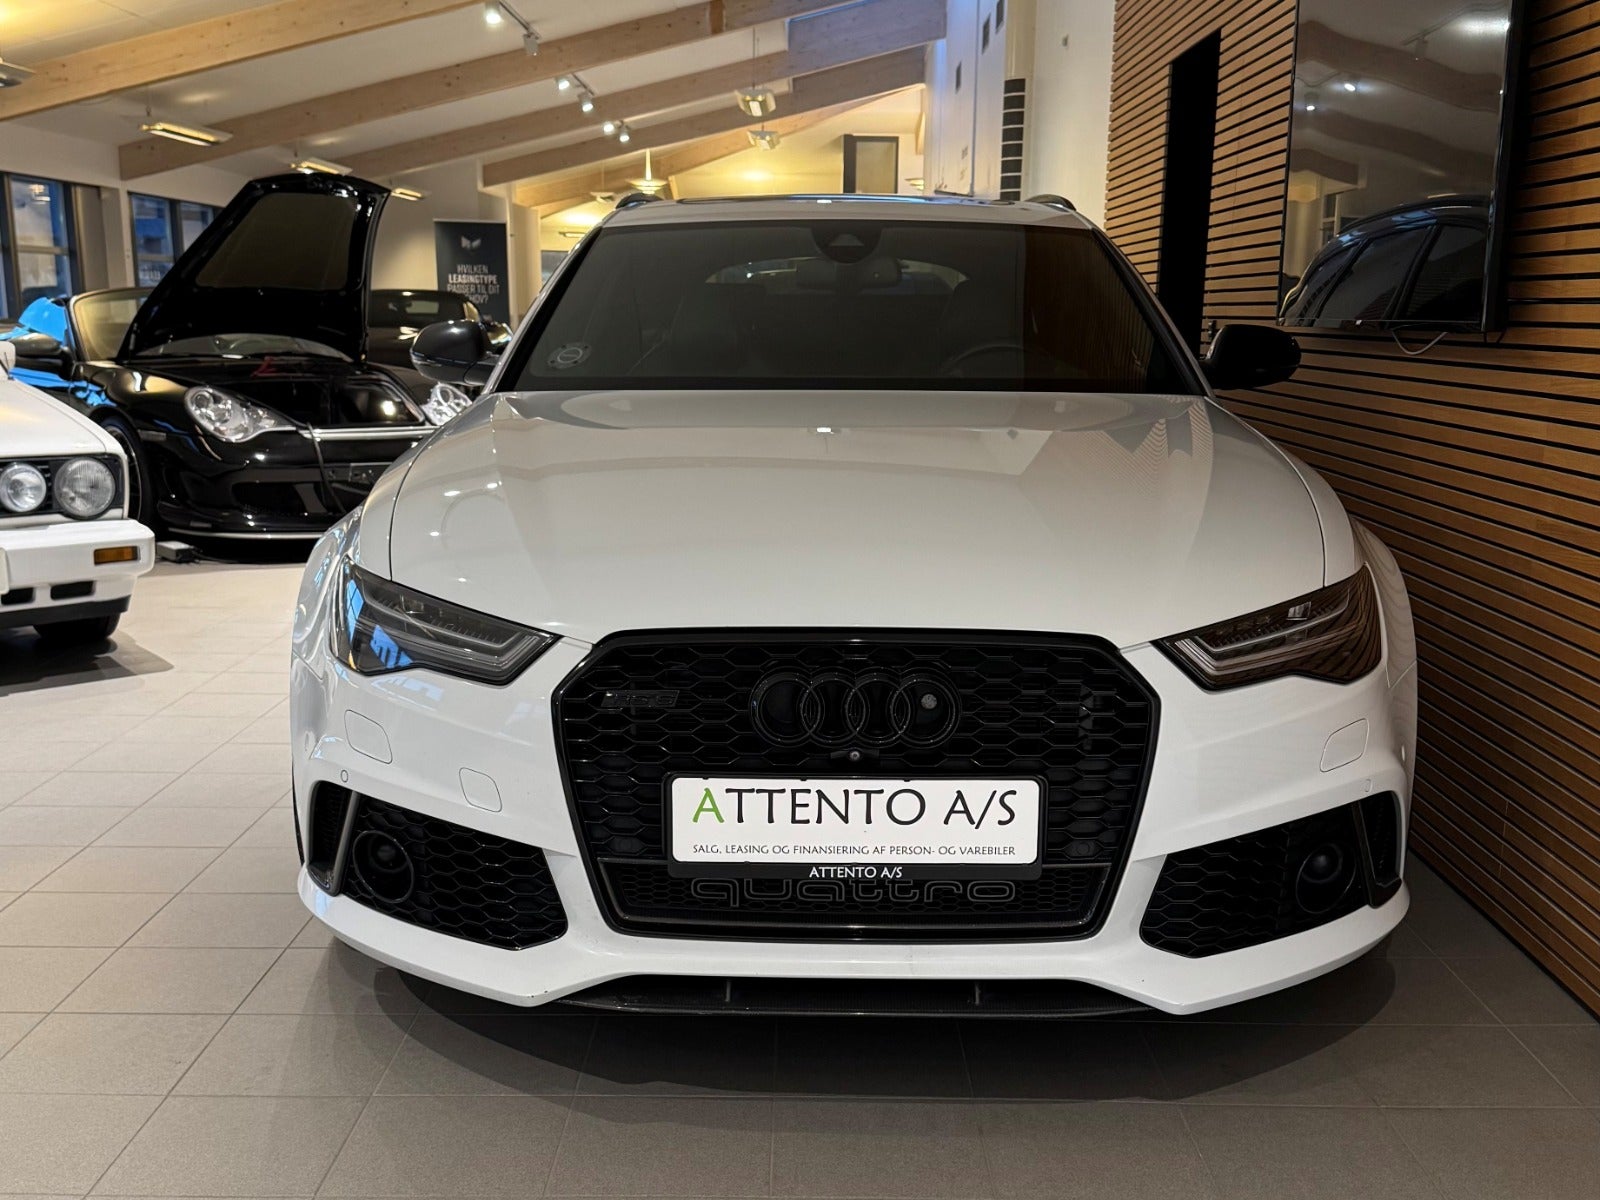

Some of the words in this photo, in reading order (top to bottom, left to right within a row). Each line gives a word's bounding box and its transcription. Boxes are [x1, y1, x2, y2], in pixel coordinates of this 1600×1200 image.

[457, 264, 489, 274] HVILKEN
[448, 273, 498, 284] LEASINGTYPE
[692, 787, 926, 826] ATTENTO
[943, 789, 1017, 830] A/S
[693, 844, 722, 855] SALG,
[725, 844, 769, 855] LEASING
[772, 844, 790, 855] OG
[793, 845, 869, 856] FINANSIERING
[873, 845, 887, 856] AF
[889, 846, 935, 856] PERSON-
[938, 846, 956, 856] OG
[959, 846, 1016, 856] VAREBILER
[809, 866, 877, 879] ATTENTO
[881, 867, 903, 880] A/S
[691, 878, 1016, 907] quattro
